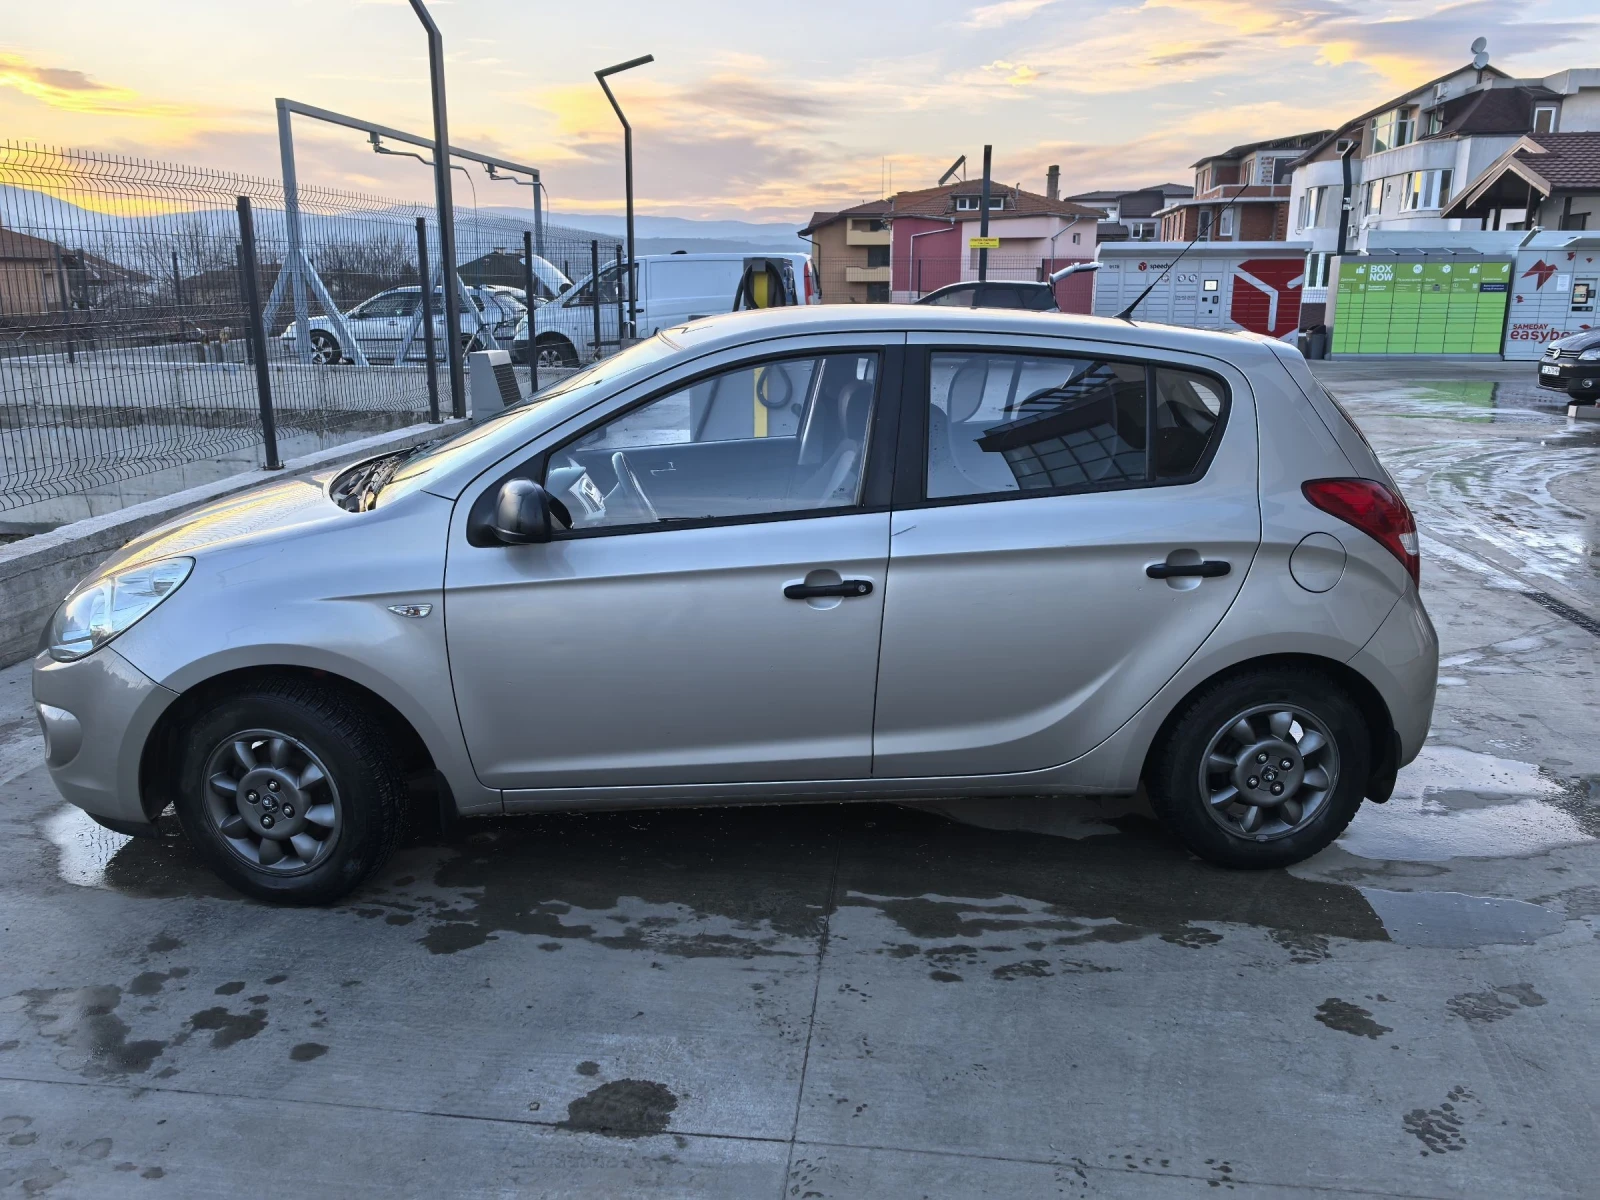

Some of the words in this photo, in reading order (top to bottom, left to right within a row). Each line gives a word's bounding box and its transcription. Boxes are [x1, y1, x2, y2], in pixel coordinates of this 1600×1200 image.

[1150, 262, 1171, 270] speedy
[1370, 264, 1392, 273] BOX
[1369, 273, 1393, 281] NOW
[1510, 328, 1574, 344] easybo
